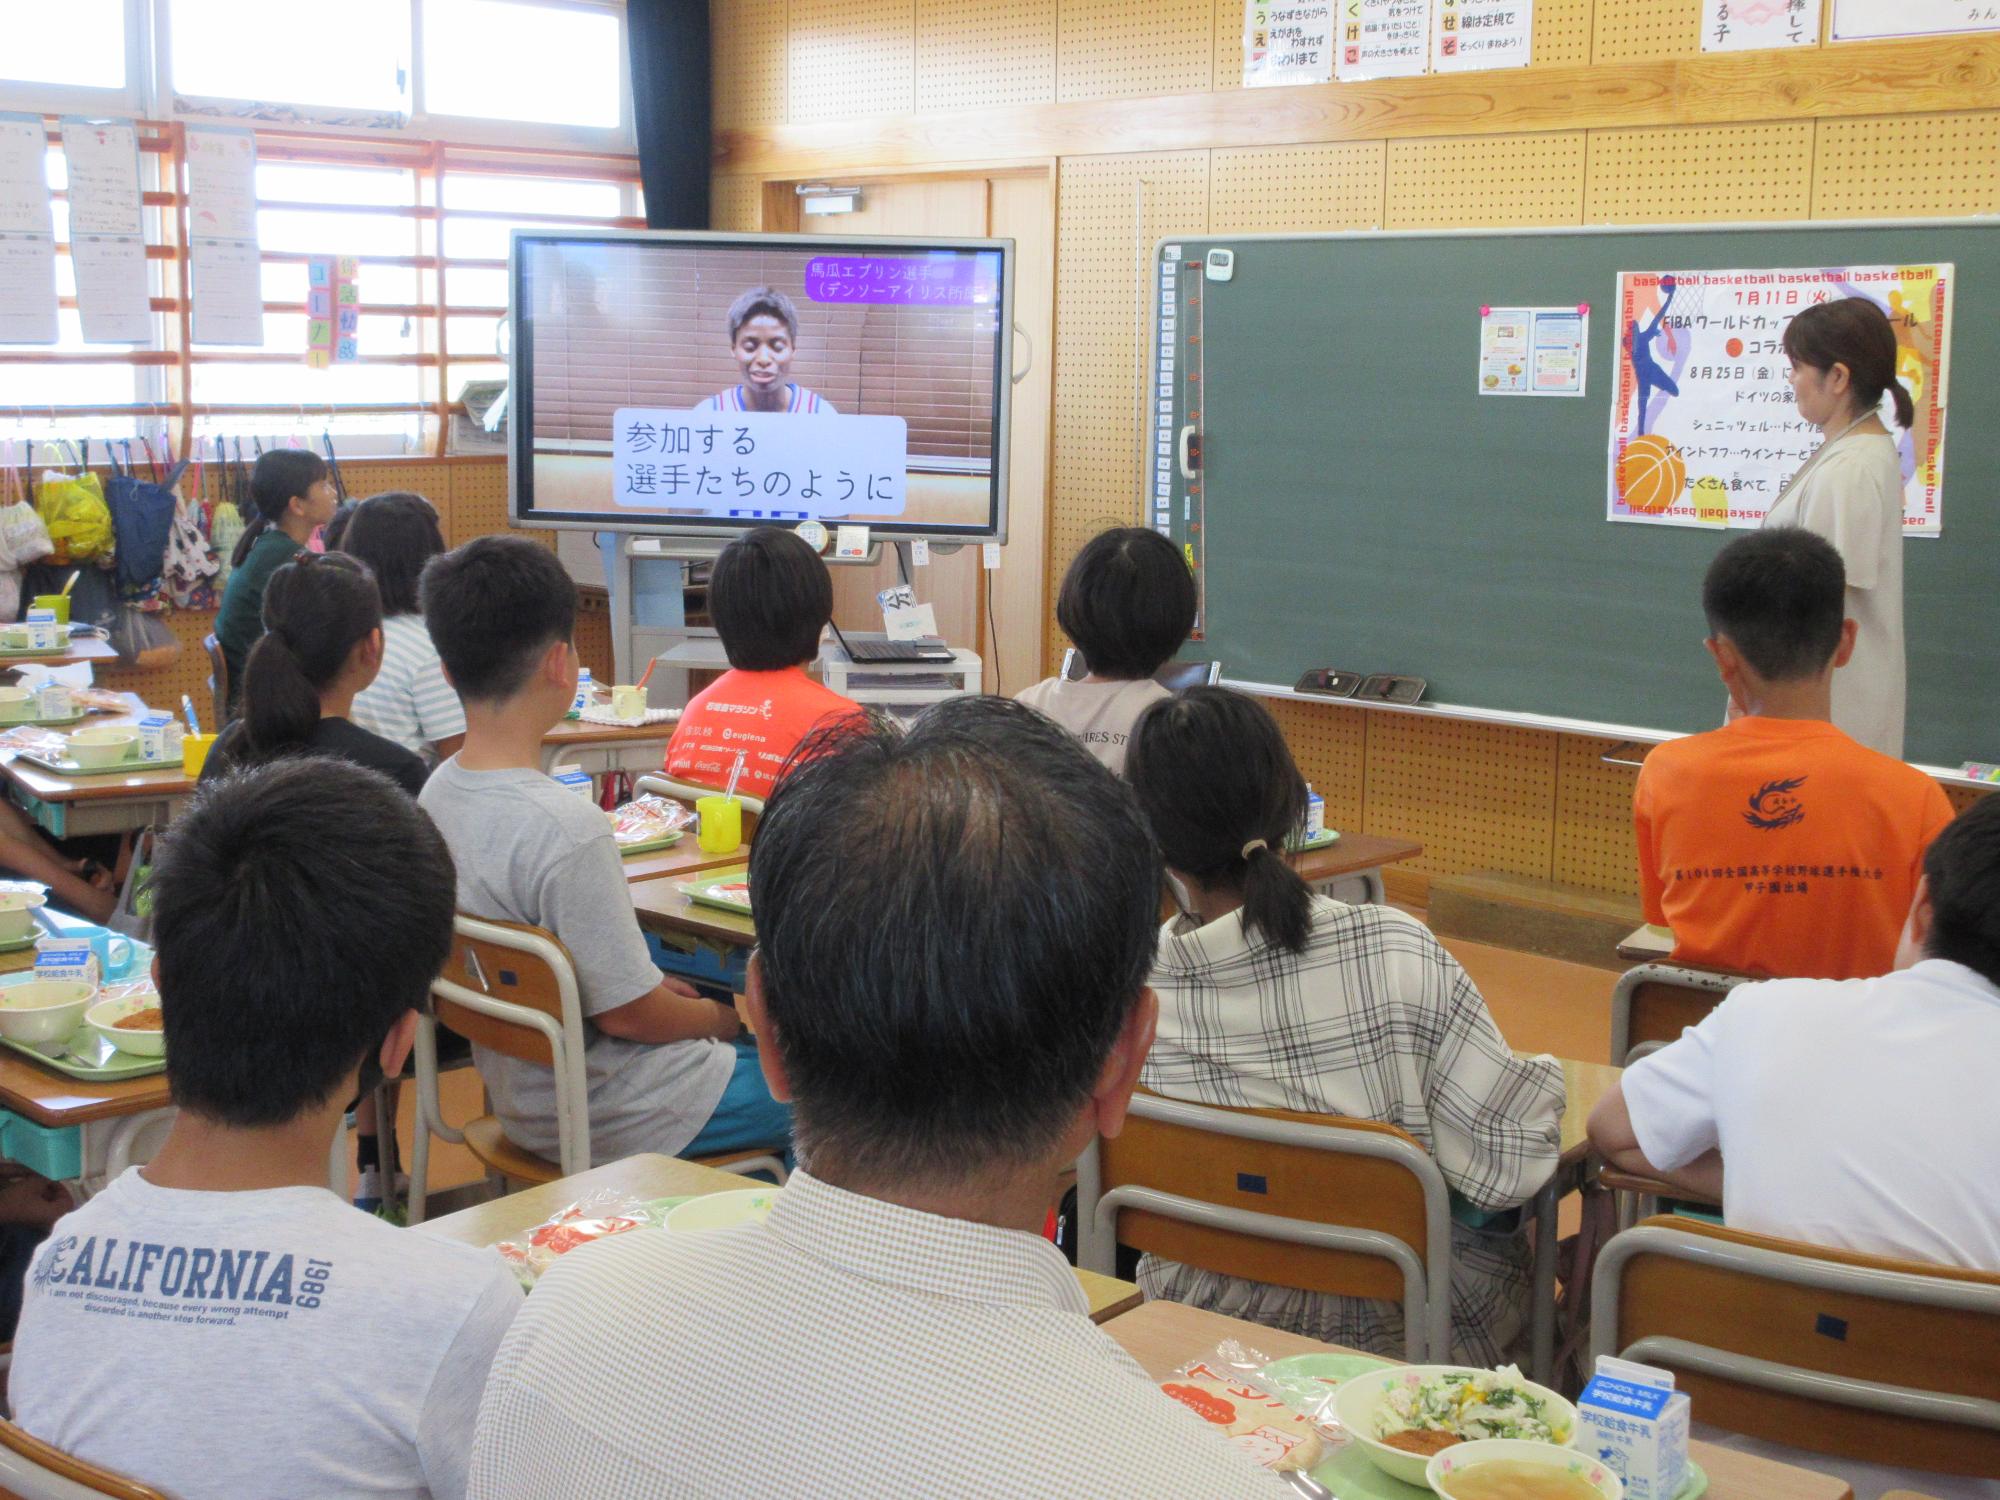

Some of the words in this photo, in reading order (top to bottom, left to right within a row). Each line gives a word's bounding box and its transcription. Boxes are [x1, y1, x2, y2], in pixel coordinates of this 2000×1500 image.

[1256, 11, 1266, 24] う
[1270, 8, 1328, 21] うなずきながら
[1348, 3, 1358, 17] く
[1444, 16, 1455, 31] せ
[1462, 12, 1515, 29] 線は定規で
[1713, 4, 1731, 43] る子
[1270, 27, 1303, 39] えがおを
[1347, 25, 1358, 39] け
[1255, 33, 1266, 47] え
[1291, 35, 1324, 47] わすれず
[1444, 40, 1454, 55] そ
[1347, 49, 1357, 64] こ
[1704, 273, 1775, 286] basketball
[1779, 271, 1850, 284] basketball
[1854, 269, 1933, 282] basketball
[1619, 365, 1631, 433] basketball
[1735, 390, 1799, 404] ドイツの家
[627, 421, 757, 456] 参加する
[1616, 437, 1627, 506] basketball
[1925, 438, 1939, 513] basketball
[625, 464, 895, 502] 選手たちのように
[1083, 731, 1109, 743] IRES
[49, 1235, 295, 1305] CALIFORNIA
[296, 1258, 334, 1309] 1989
[69, 1290, 84, 1299] not
[182, 1303, 208, 1314] every
[211, 1305, 241, 1315] wrong
[243, 1306, 289, 1320] attempt
[137, 1311, 171, 1321] another
[195, 1315, 237, 1326] forward.
[1582, 1410, 1652, 1438] 学校給食牛乳
